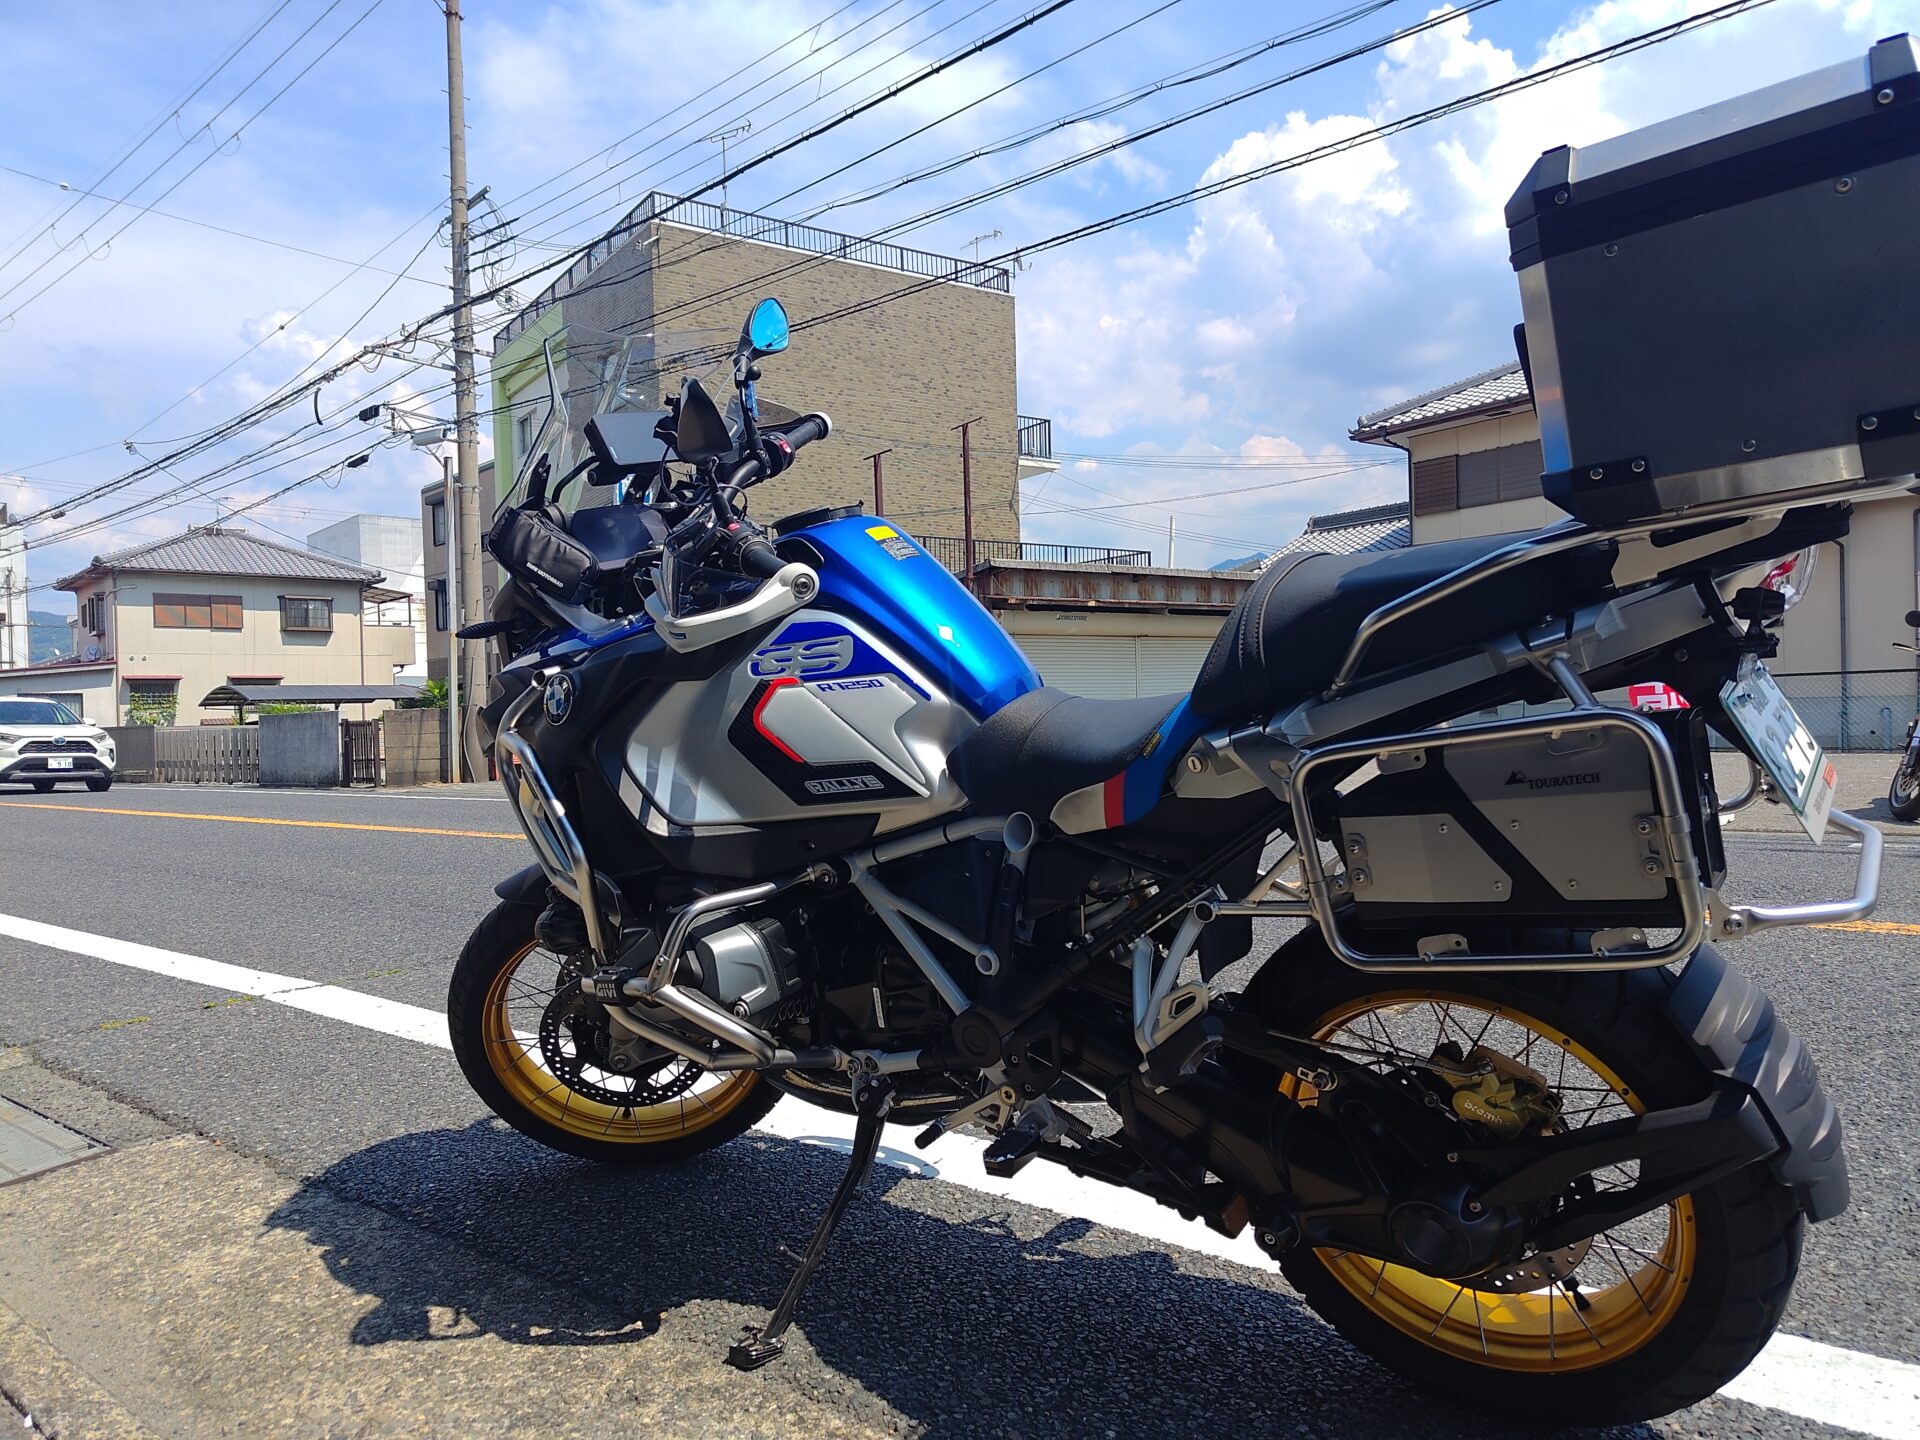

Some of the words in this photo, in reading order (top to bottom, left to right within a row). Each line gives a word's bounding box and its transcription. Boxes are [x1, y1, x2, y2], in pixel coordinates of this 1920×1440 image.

[816, 679, 885, 692] R1250
[805, 776, 884, 793] RALLYE
[1527, 772, 1600, 789] TOURATECH
[596, 983, 617, 998] GIVI
[1464, 1098, 1508, 1127] bremb
